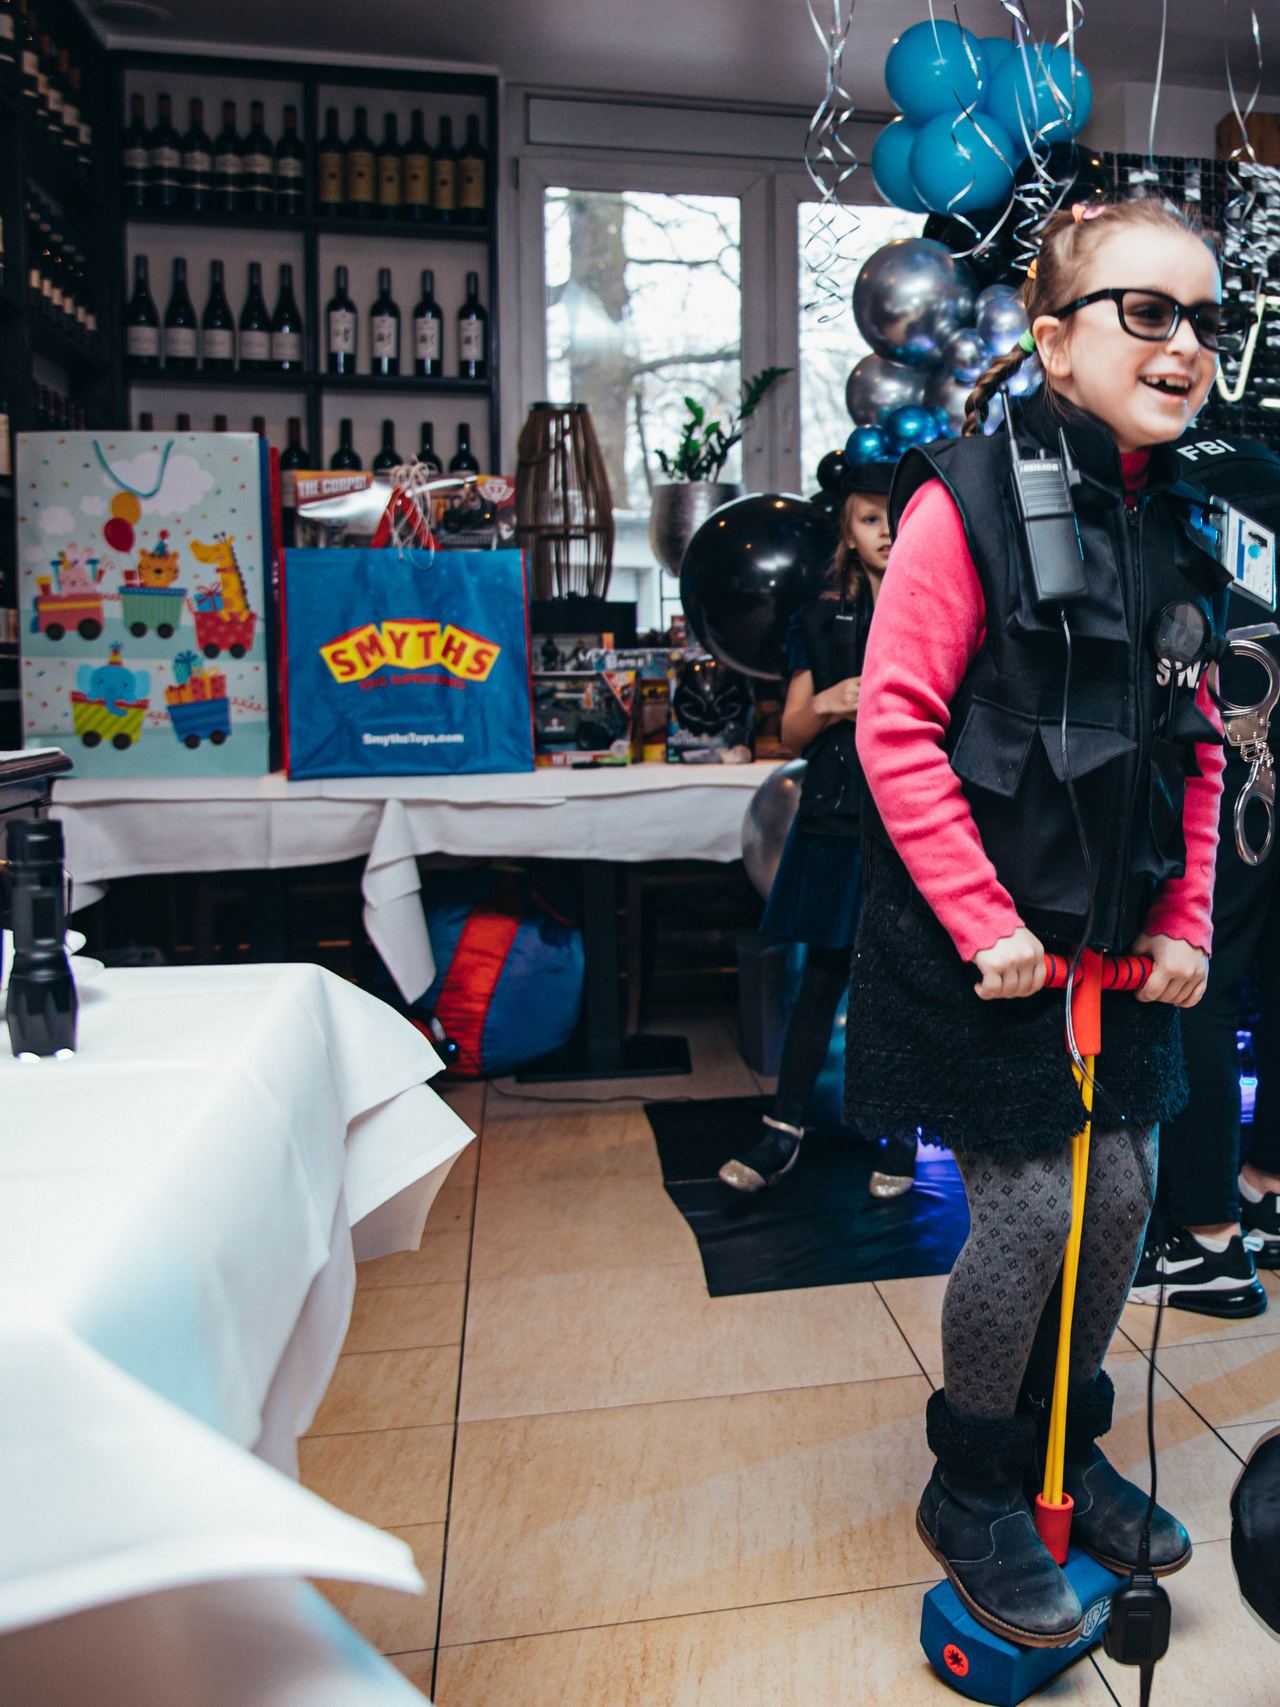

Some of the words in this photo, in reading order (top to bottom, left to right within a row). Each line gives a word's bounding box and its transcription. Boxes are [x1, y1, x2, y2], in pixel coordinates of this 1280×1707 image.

[1177, 439, 1236, 461] FBI
[299, 479, 320, 497] THE
[322, 475, 366, 494] CORPS!
[330, 629, 494, 677] SMYTHS
[362, 732, 464, 746] SmythsToys.com
